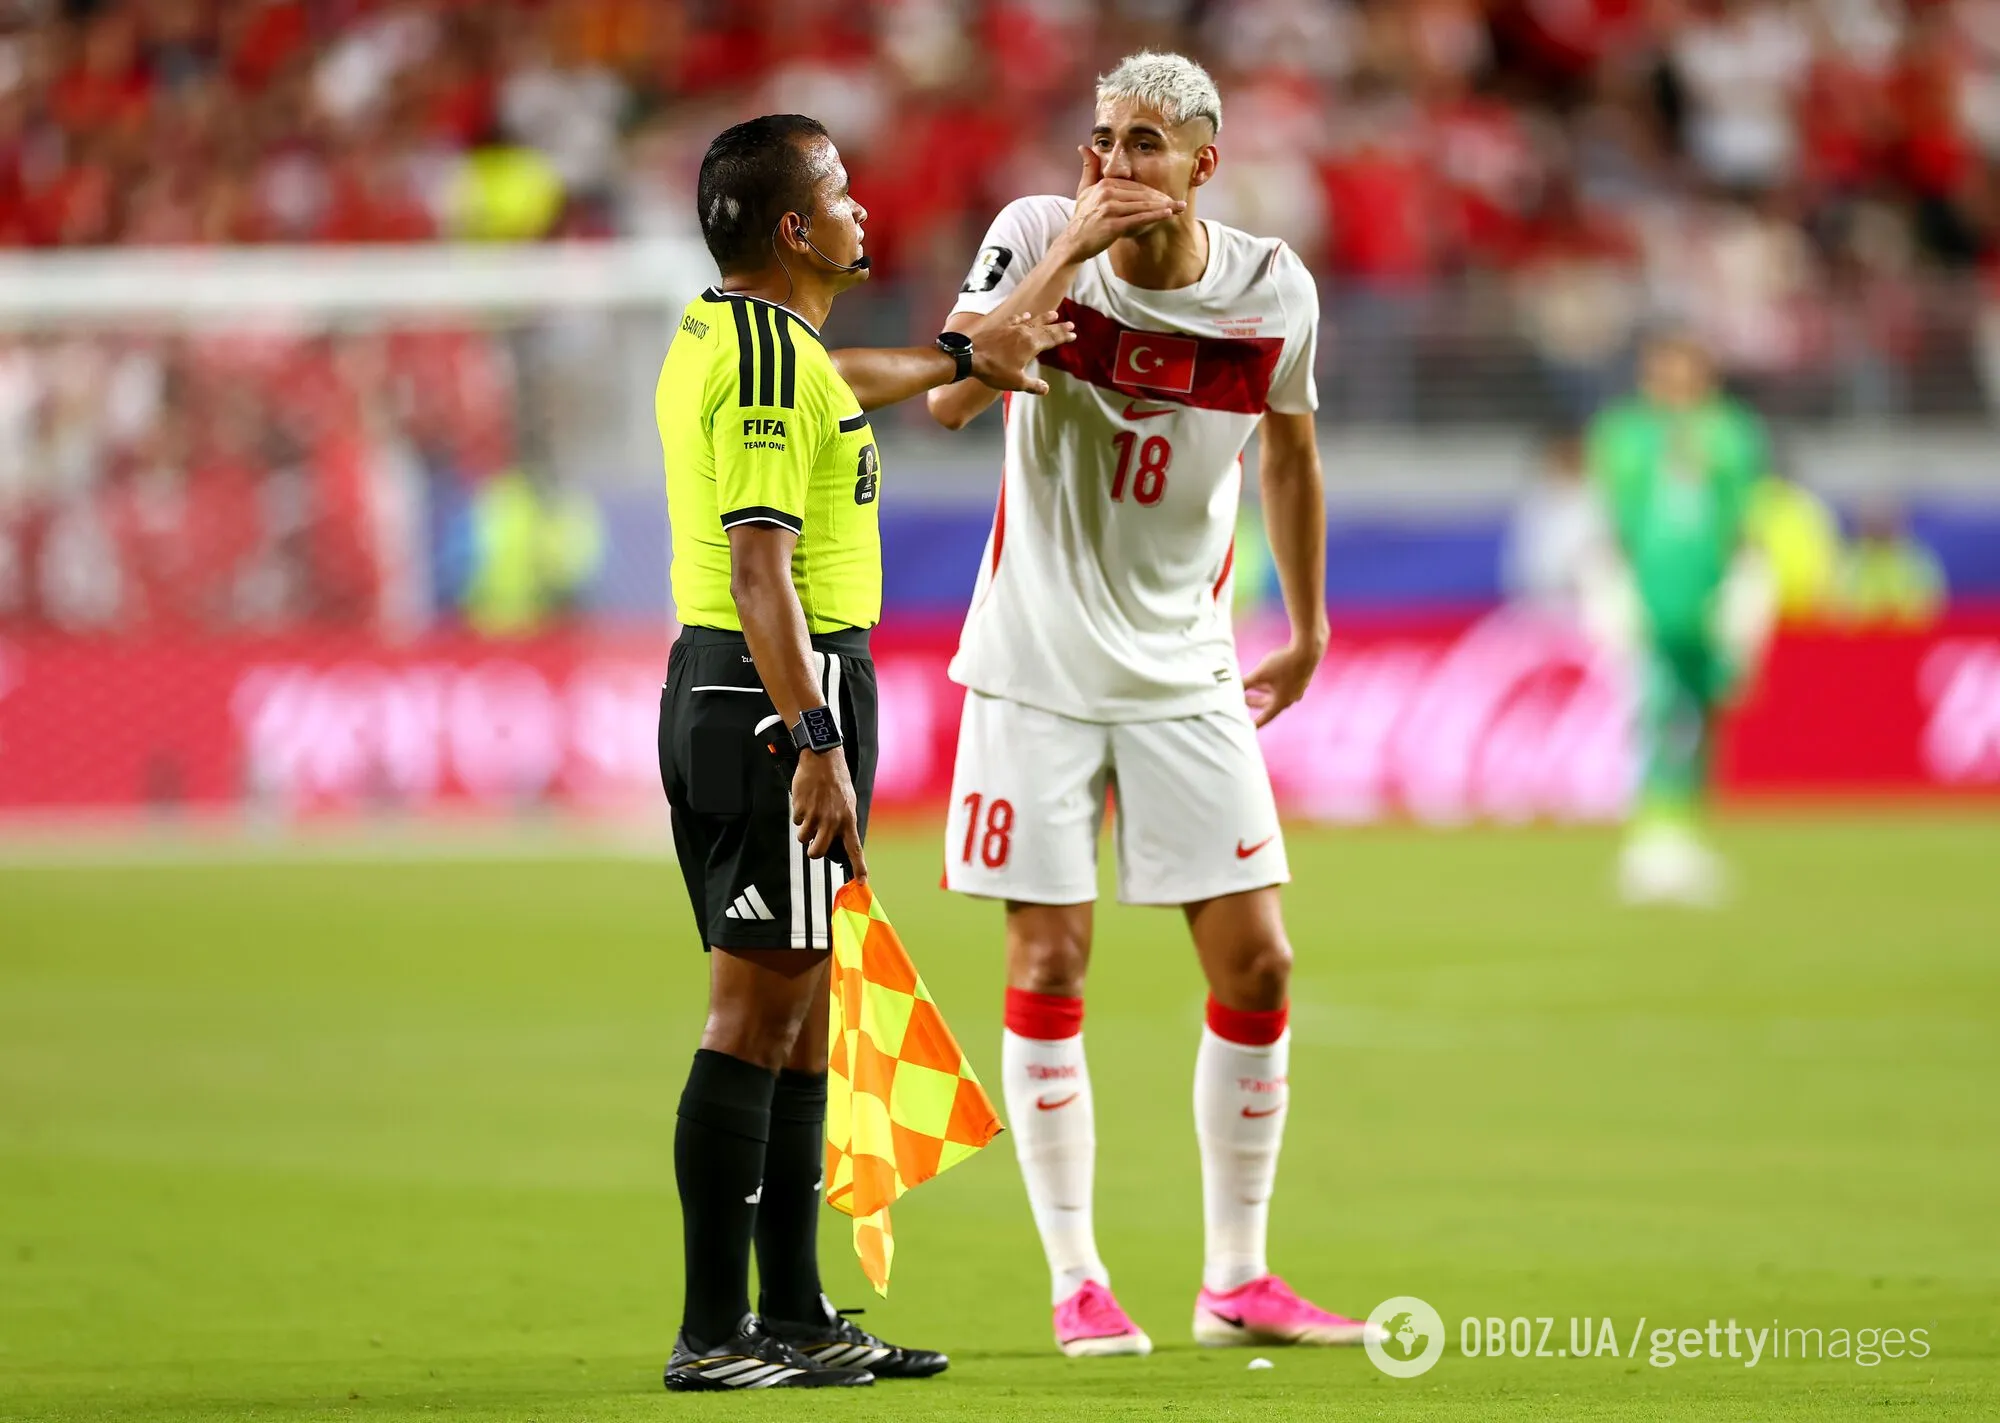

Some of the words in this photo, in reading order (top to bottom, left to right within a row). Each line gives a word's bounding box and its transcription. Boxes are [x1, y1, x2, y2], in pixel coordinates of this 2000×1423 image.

[683, 315, 709, 340] SANTOS
[743, 419, 786, 437] FIFA
[743, 441, 766, 449] TEAM
[768, 442, 785, 451] ONE
[1110, 430, 1173, 507] 18
[962, 791, 1014, 869] 18
